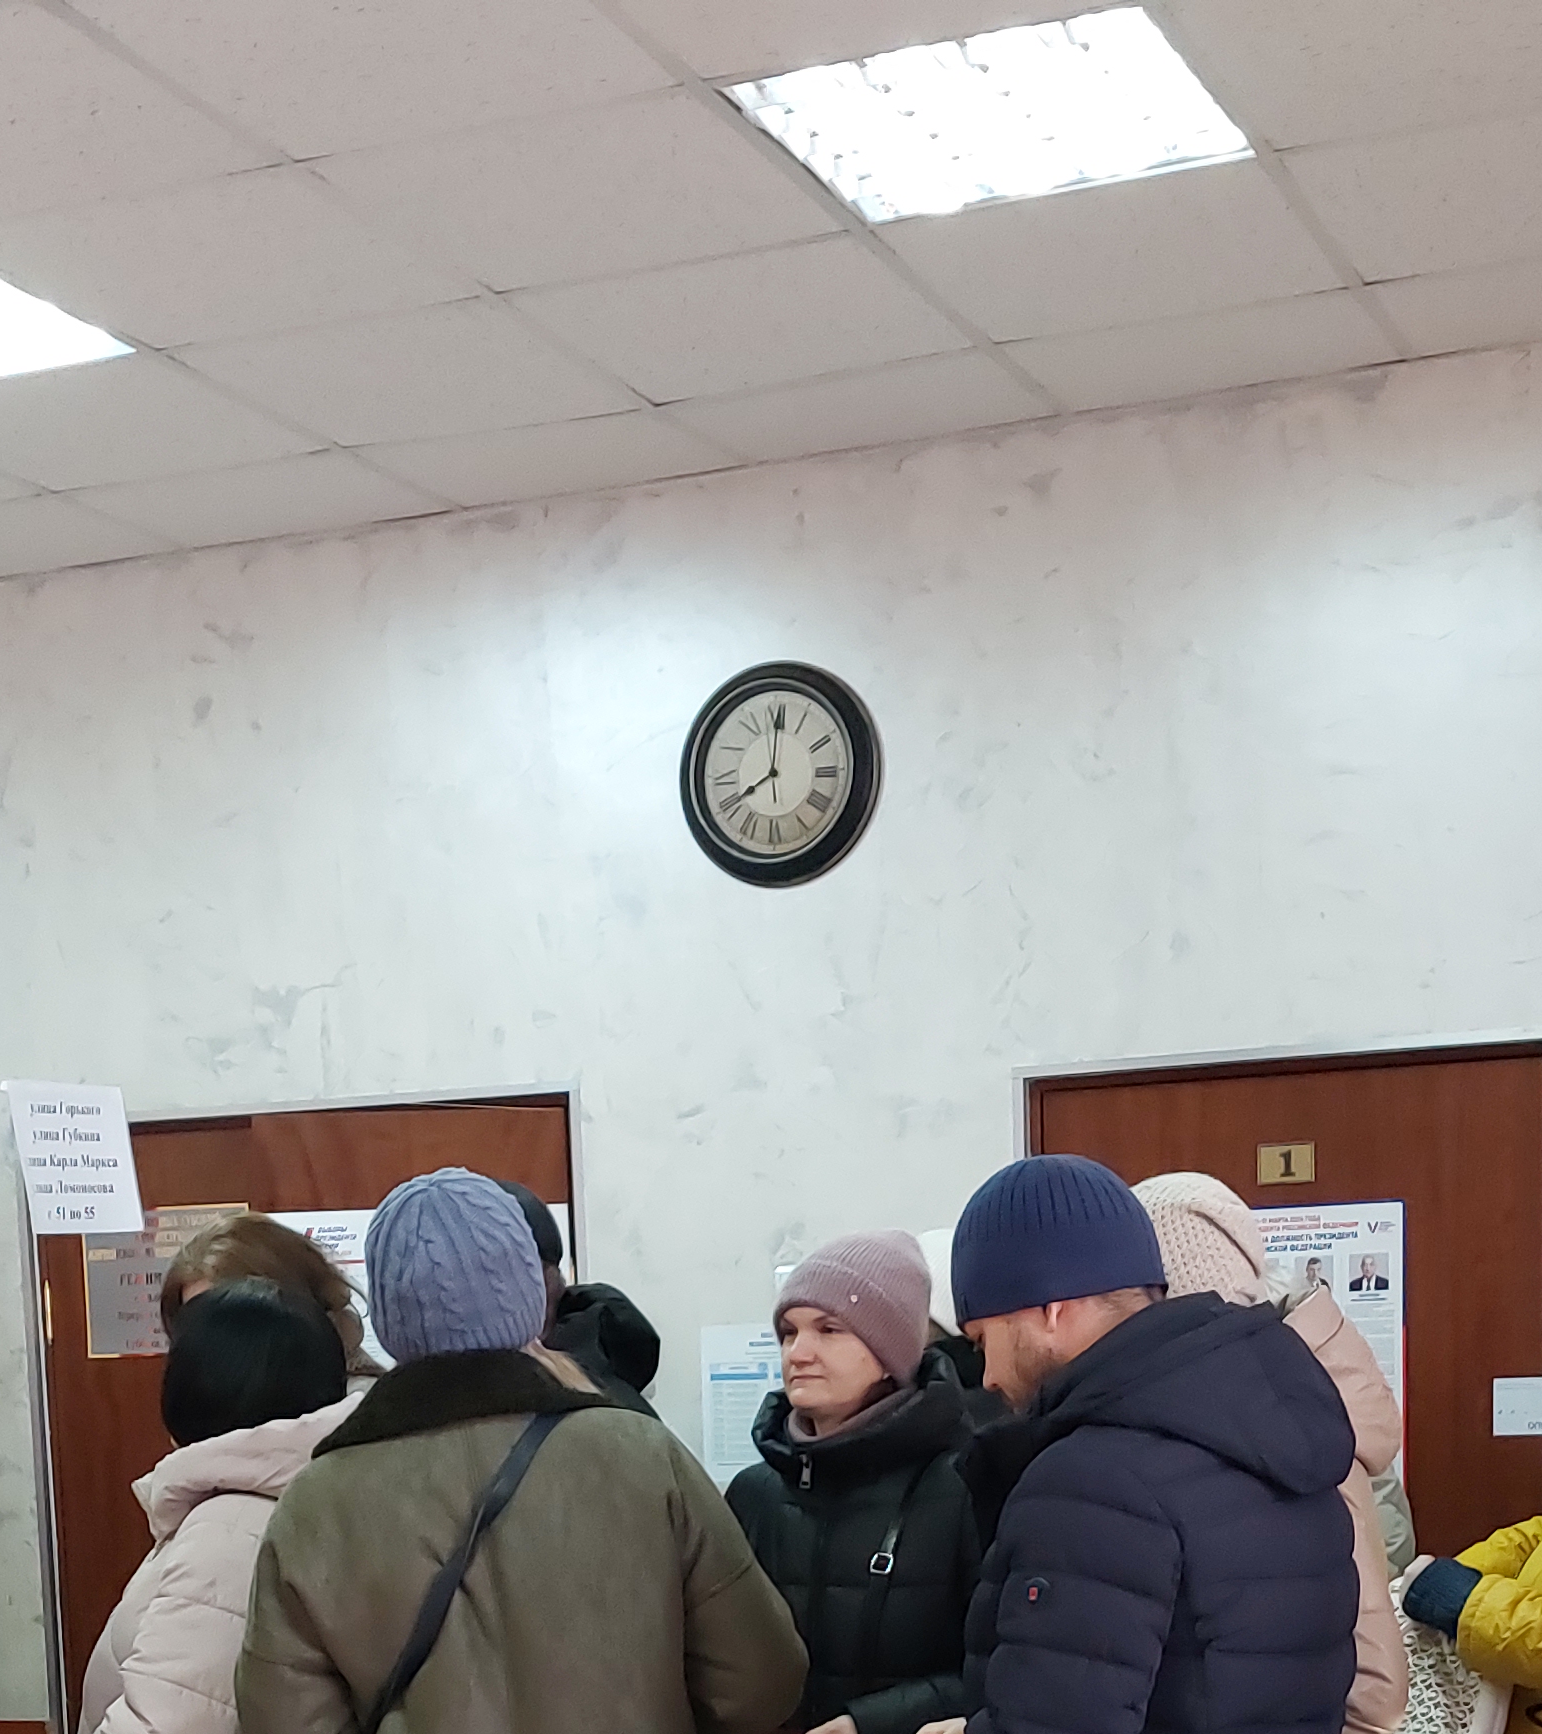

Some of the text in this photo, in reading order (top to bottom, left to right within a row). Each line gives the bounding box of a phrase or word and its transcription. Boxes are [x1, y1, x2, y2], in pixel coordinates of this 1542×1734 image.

[30, 1101, 101, 1118] улица Горького
[32, 1127, 101, 1145] улица Губкина
[49, 1154, 78, 1171] Карла
[81, 1154, 118, 1171] Маркса
[1279, 1149, 1296, 1177] 1
[56, 1180, 115, 1194] Ломоносова
[70, 1210, 81, 1220] по
